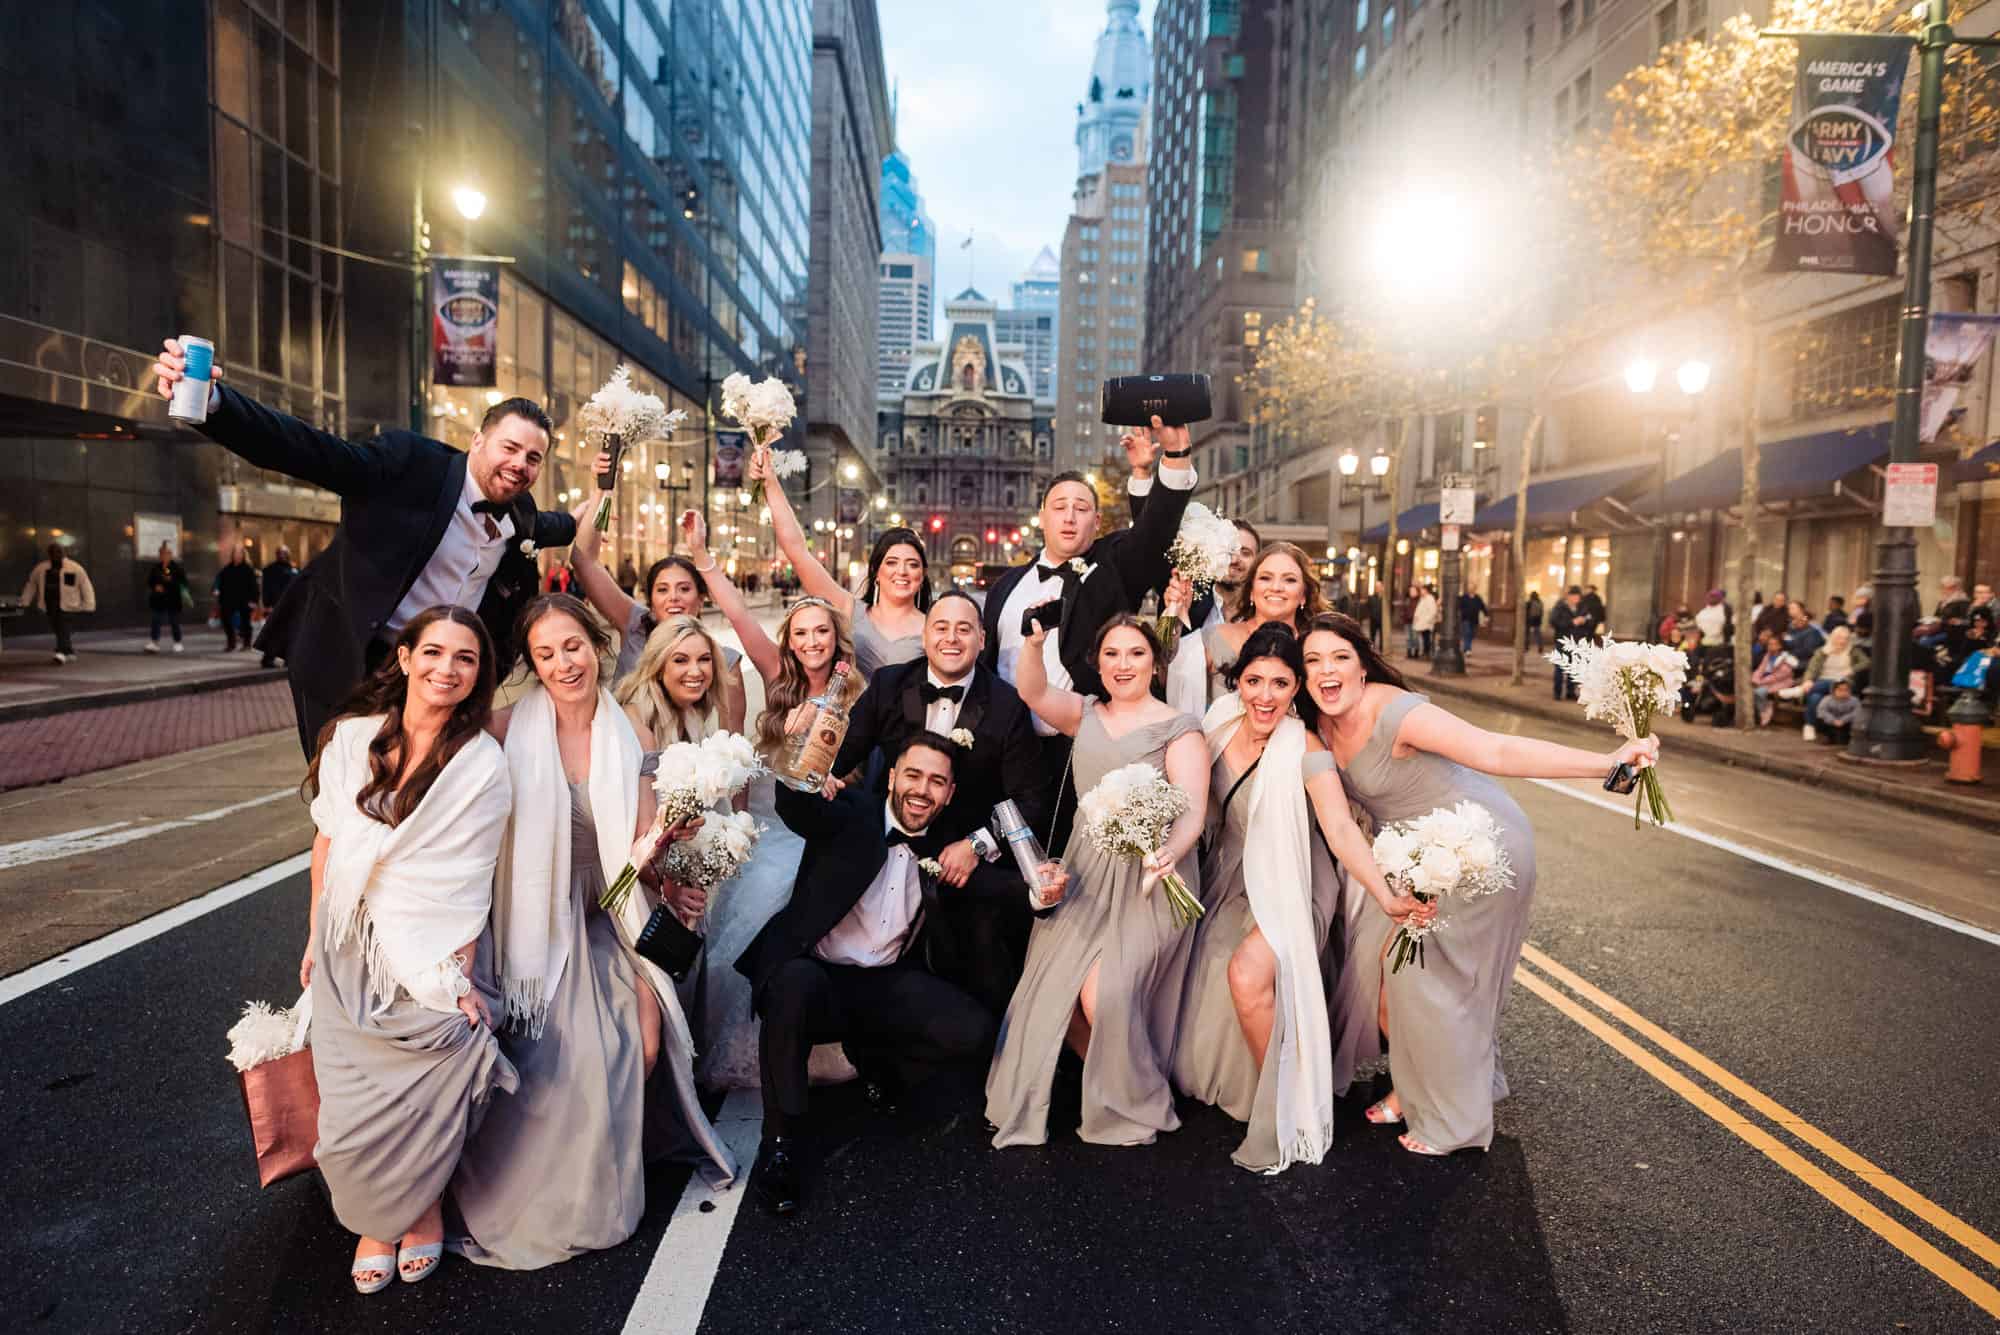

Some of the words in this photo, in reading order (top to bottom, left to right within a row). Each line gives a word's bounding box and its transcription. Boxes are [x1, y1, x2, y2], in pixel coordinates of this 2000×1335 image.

[1806, 60, 1888, 77] AMERICA'S
[1819, 78, 1864, 93] GAME
[1813, 146, 1859, 162] AVY
[1783, 213, 1879, 235] HONOR
